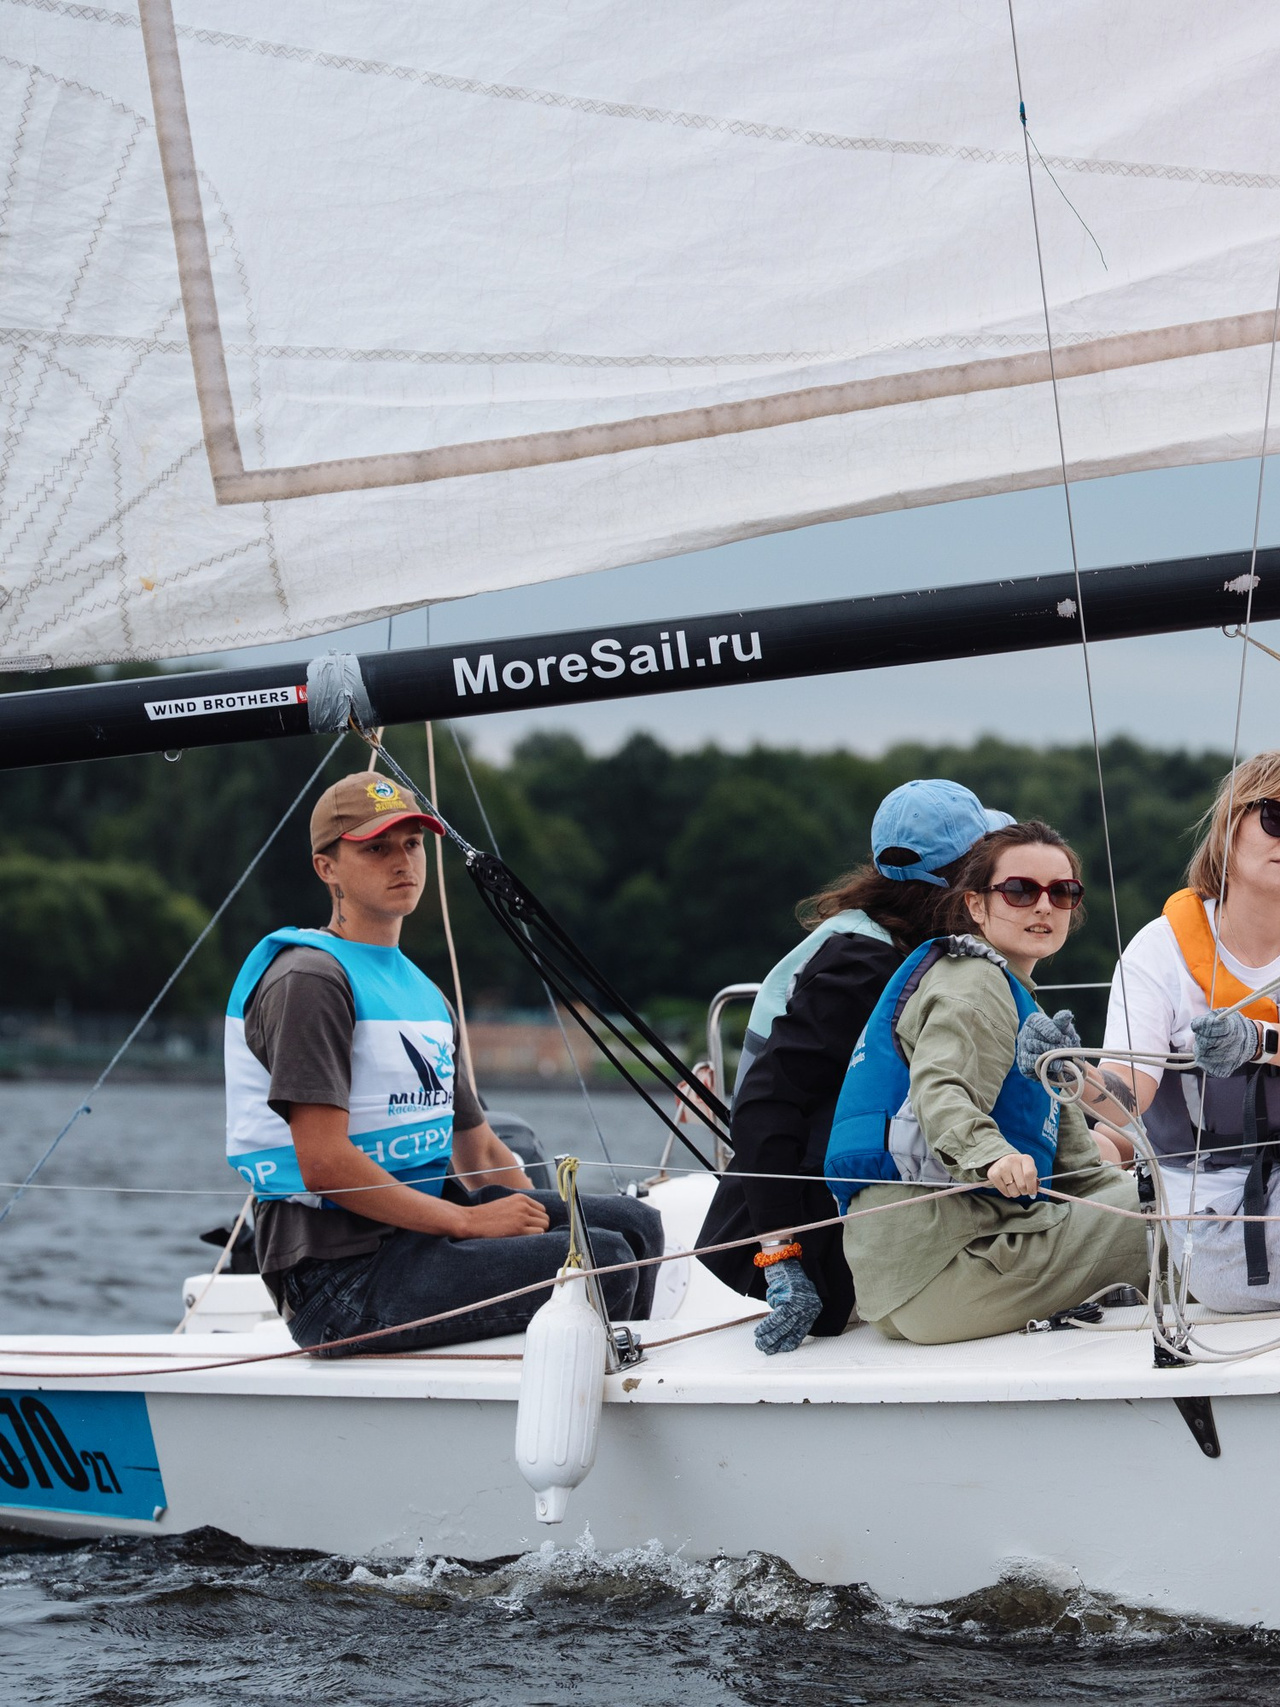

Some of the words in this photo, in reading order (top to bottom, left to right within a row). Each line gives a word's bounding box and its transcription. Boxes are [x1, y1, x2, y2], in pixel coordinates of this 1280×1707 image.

[452, 630, 763, 697] MoreSail.ru
[152, 701, 197, 716] WIND
[203, 690, 290, 711] BROTHERS
